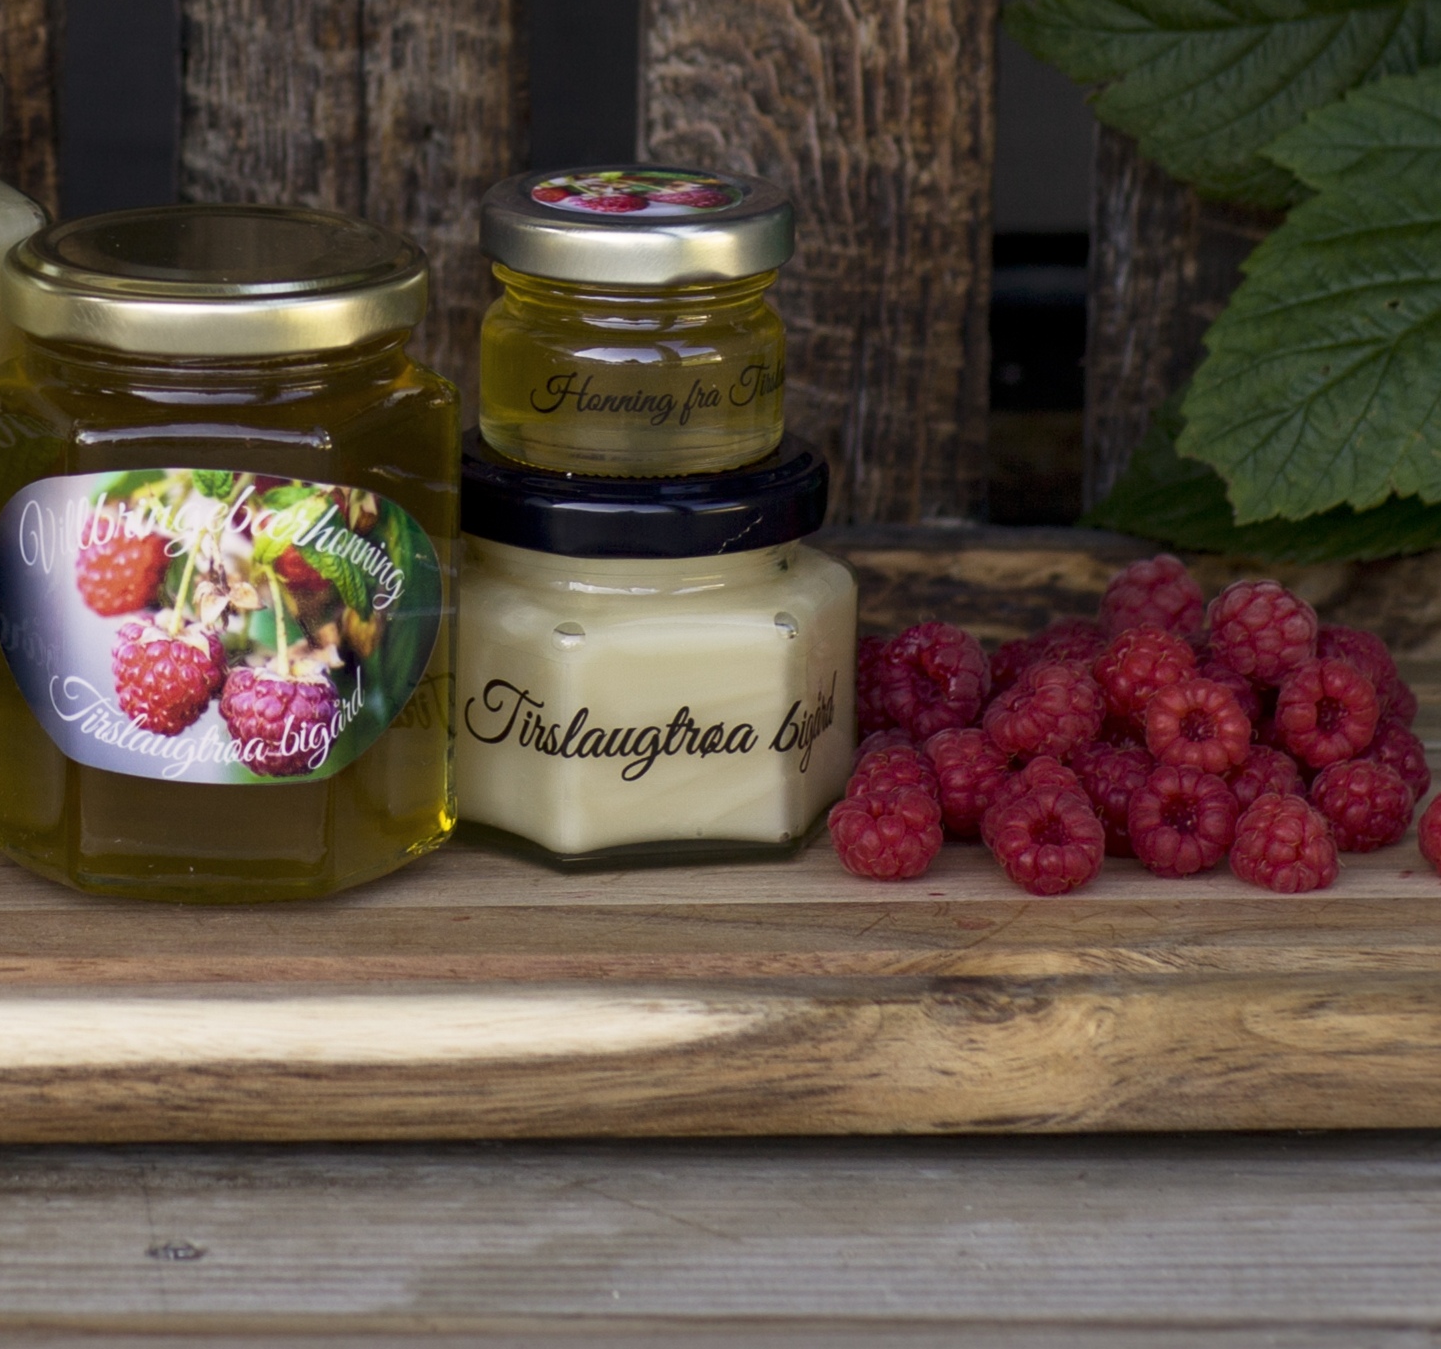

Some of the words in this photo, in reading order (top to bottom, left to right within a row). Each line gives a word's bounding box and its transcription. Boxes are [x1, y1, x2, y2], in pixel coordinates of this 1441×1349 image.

[530, 371, 679, 426] Honning
[679, 378, 723, 426] fra
[49, 674, 274, 779] Tirslaugtrøa
[272, 666, 367, 770] bigård
[464, 678, 759, 781] Tirslaugtrøa
[768, 670, 838, 774] bigård
